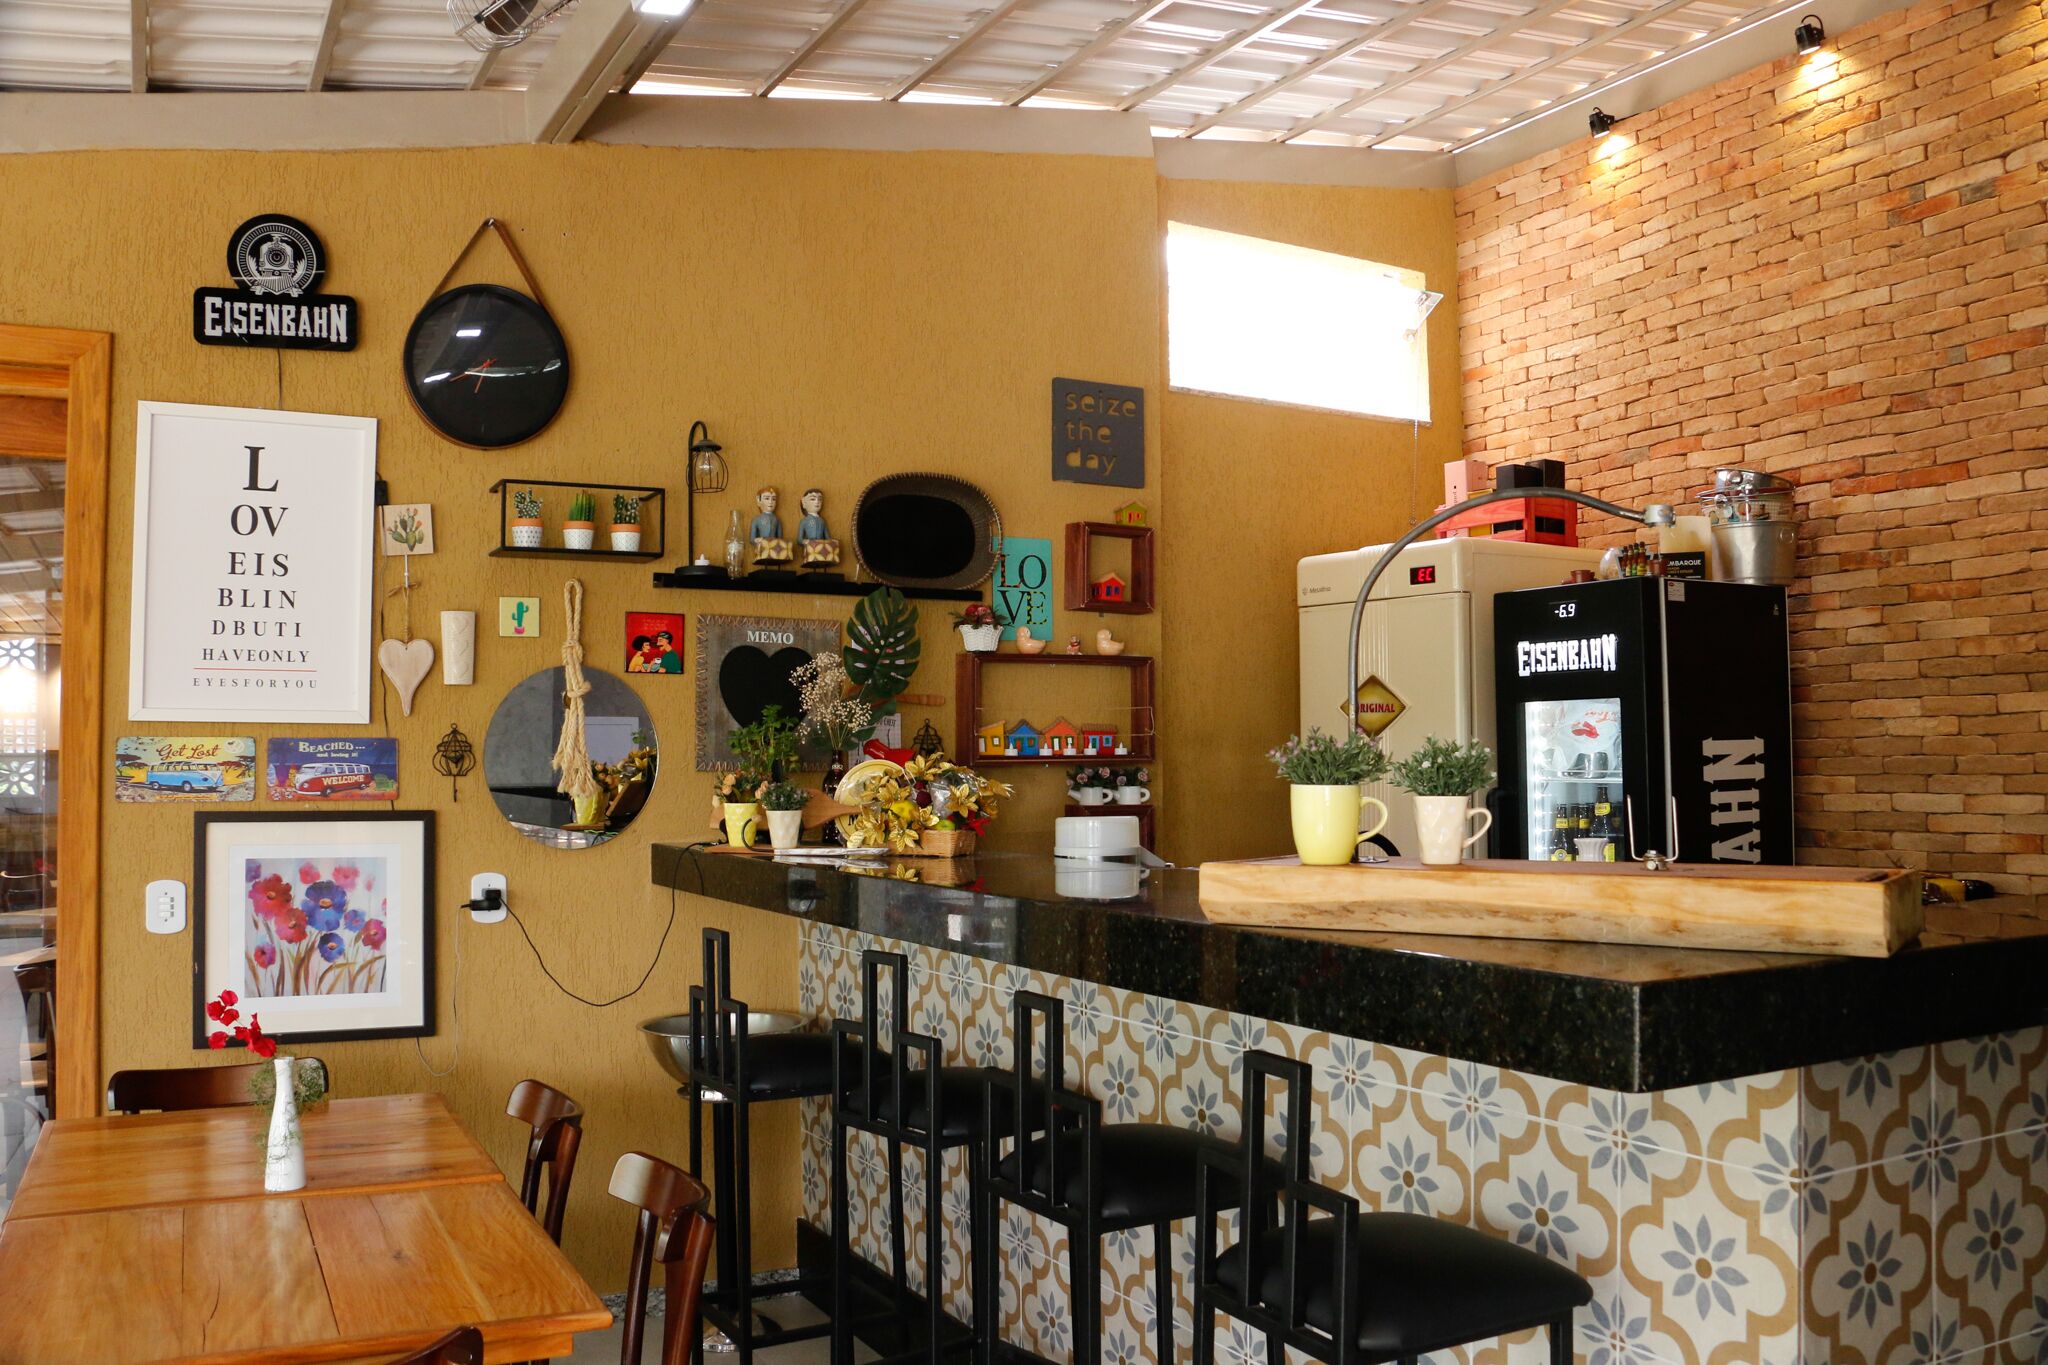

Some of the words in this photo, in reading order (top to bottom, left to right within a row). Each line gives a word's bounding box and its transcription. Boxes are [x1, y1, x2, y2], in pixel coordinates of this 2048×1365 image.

[204, 296, 348, 343] EISENBAHN
[1065, 390, 1137, 417] seize
[1065, 418, 1112, 443] the
[242, 445, 279, 492] L
[1065, 446, 1117, 477] day
[230, 504, 288, 537] OV
[228, 551, 289, 577] EIS
[1666, 559, 1702, 567] MBARQUE
[217, 587, 296, 609] BLIN
[211, 619, 301, 638] DBUTI
[746, 630, 794, 645] MEMO
[1517, 634, 1616, 677] EISENBAHN
[1357, 703, 1396, 713] RIGINAL
[157, 743, 187, 760] Get
[186, 744, 221, 760] Lost
[322, 775, 365, 786] WELCOME
